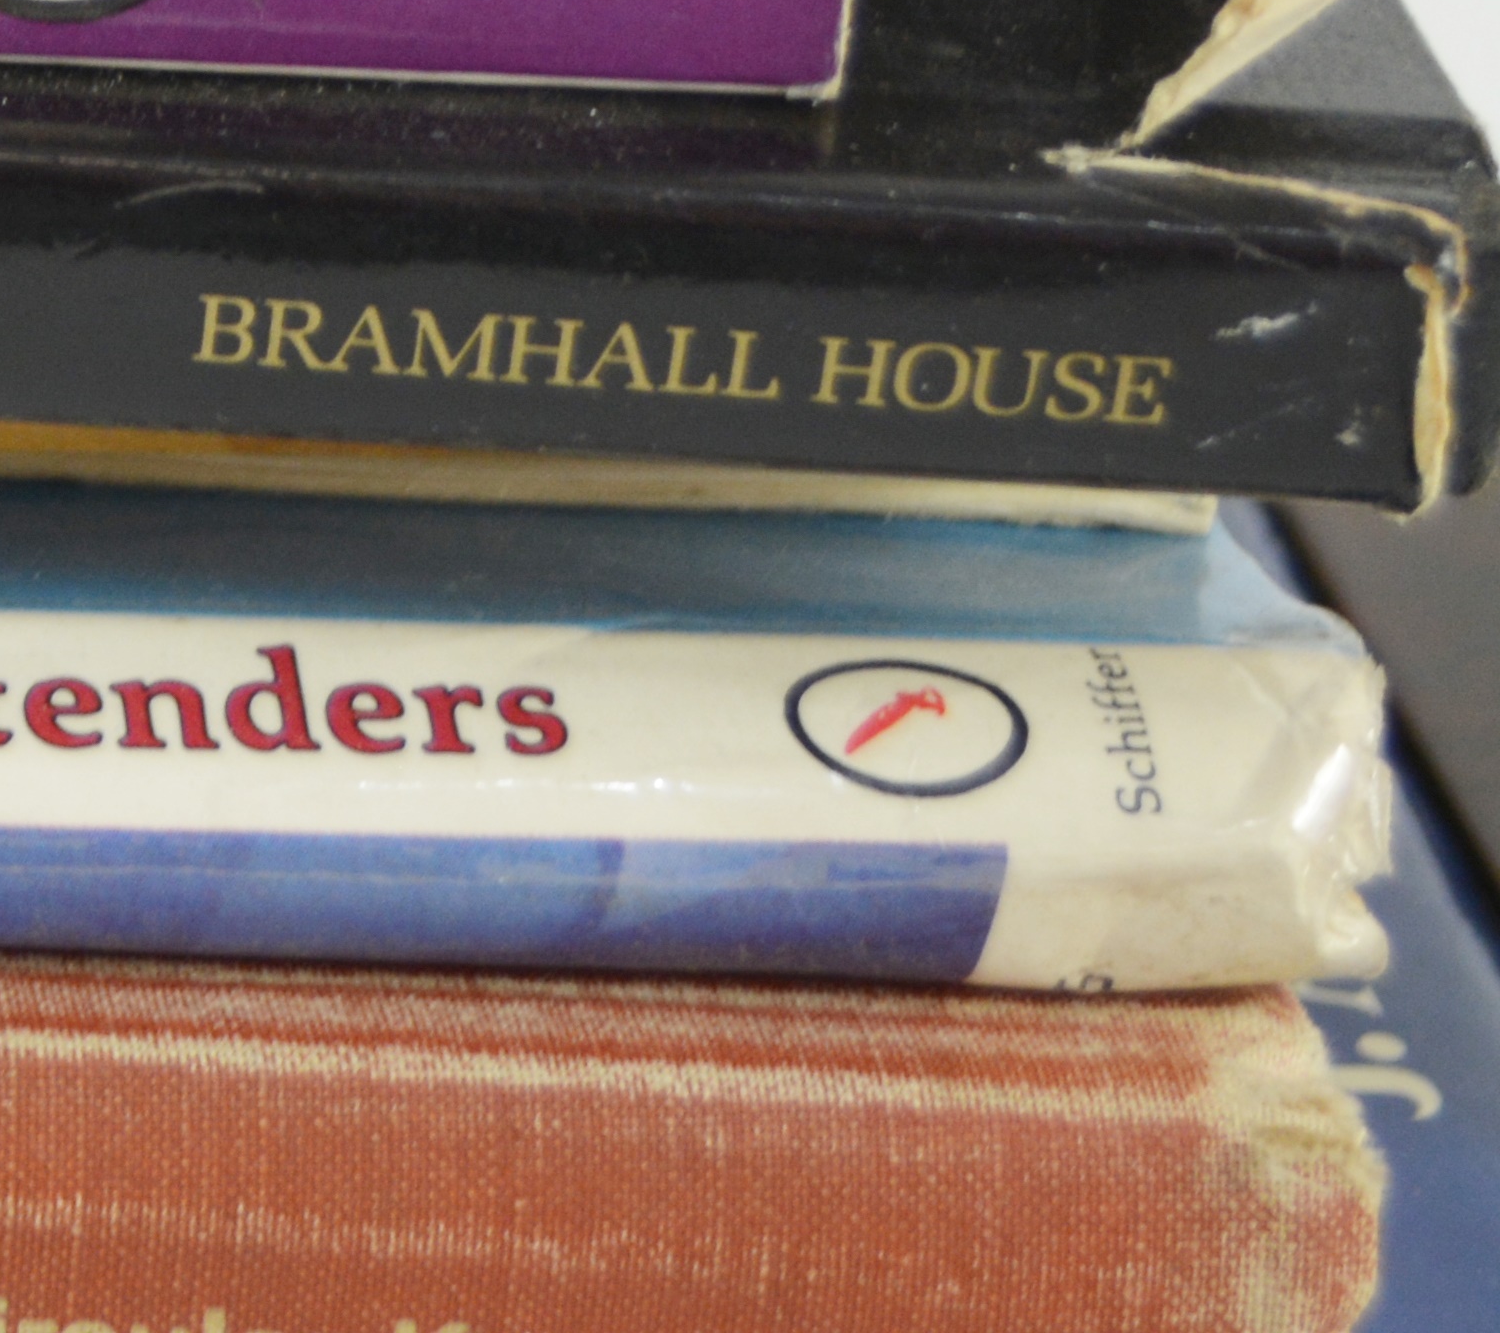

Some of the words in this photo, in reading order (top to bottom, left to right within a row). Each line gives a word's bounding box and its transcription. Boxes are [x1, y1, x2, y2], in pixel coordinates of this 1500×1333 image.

[191, 293, 780, 401] BRAMHALL
[808, 337, 1173, 427] HOUSE
[1082, 646, 1163, 816] Schiffer
